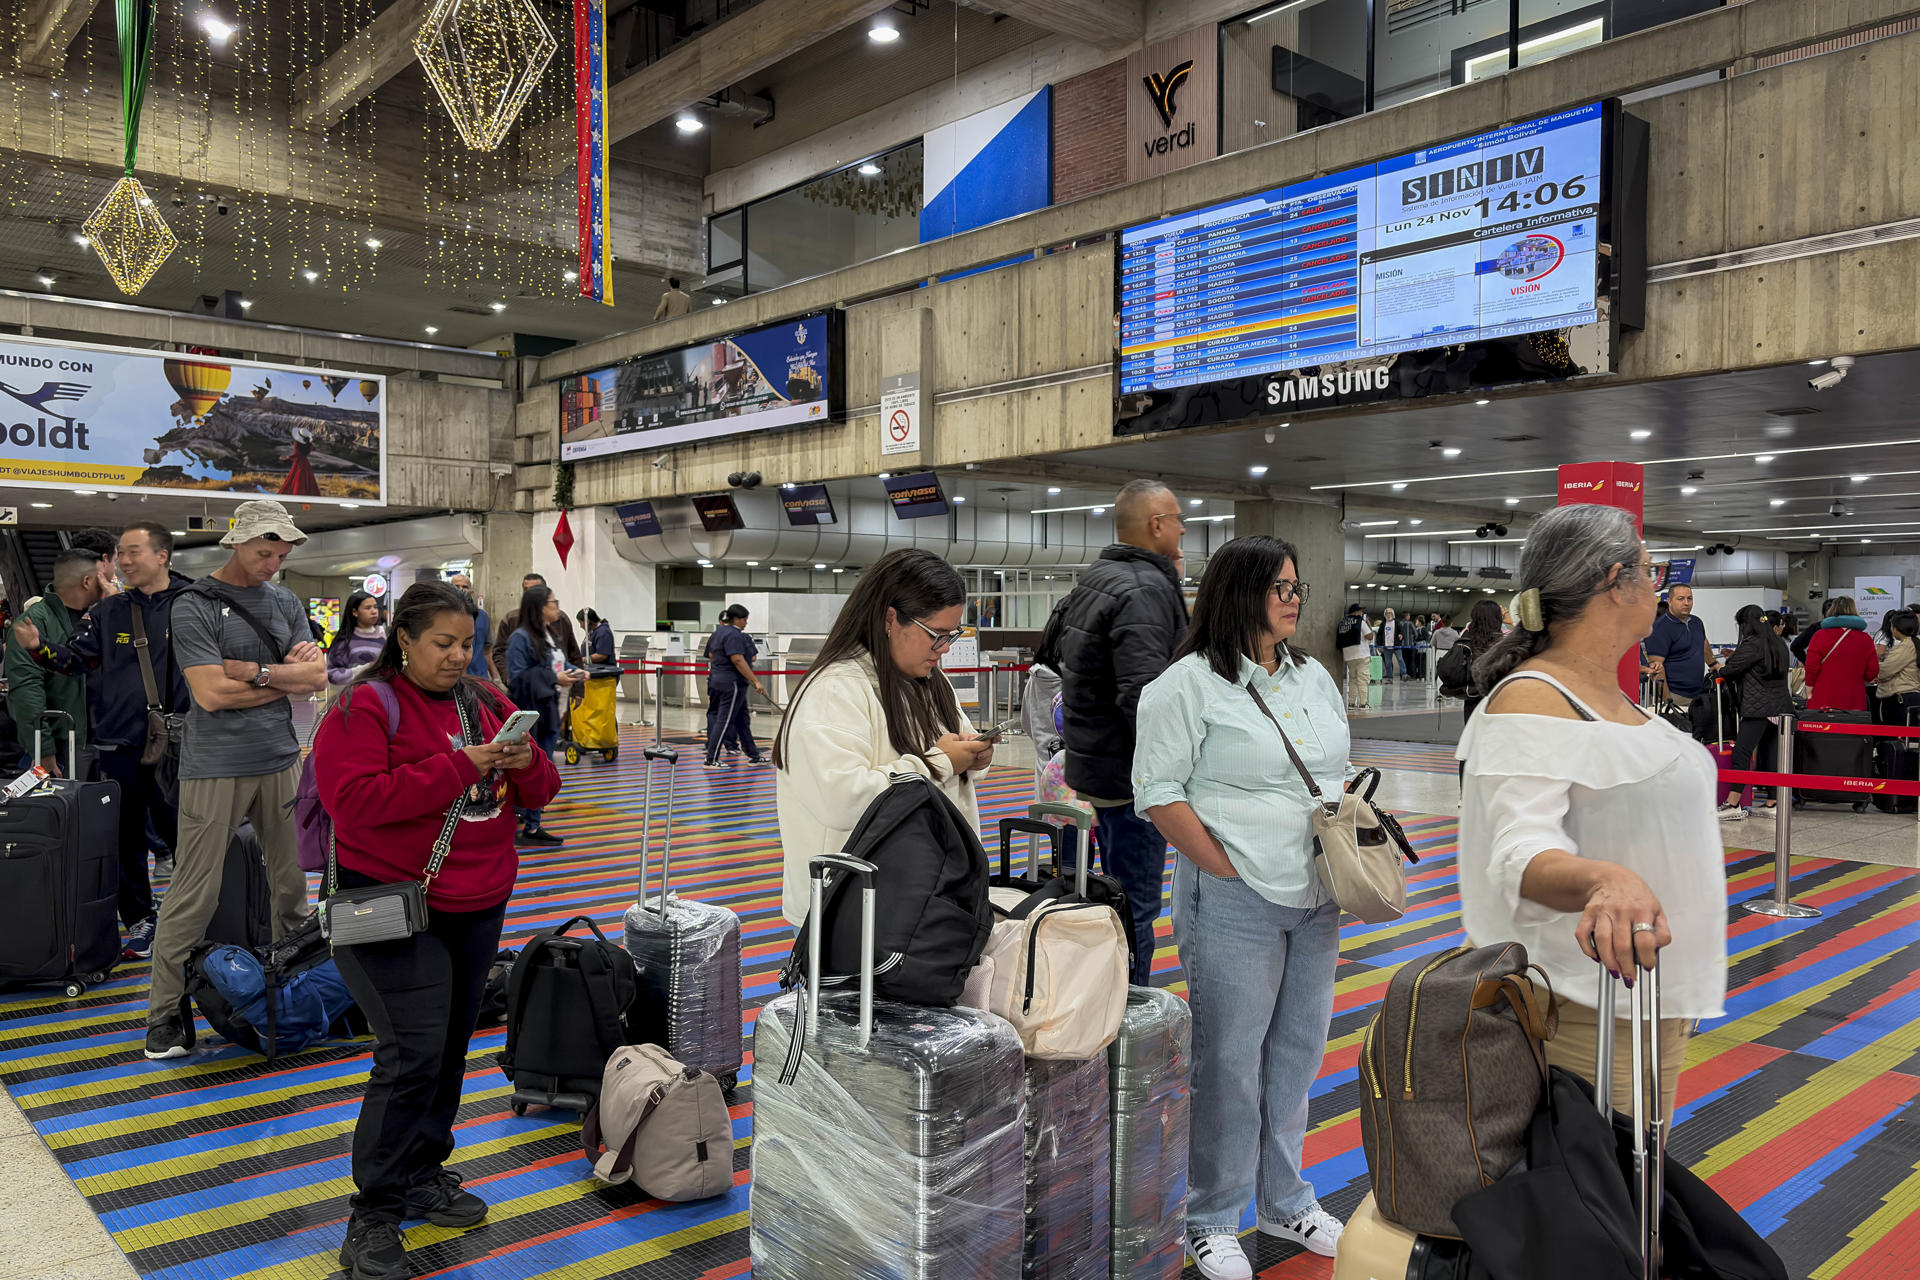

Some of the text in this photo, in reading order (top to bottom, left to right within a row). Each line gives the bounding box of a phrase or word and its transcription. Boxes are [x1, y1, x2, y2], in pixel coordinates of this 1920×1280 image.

[1144, 123, 1195, 158] verdi
[1428, 137, 1475, 155] AEROPUERTO
[1477, 120, 1538, 142] INTERNACIONAL
[1404, 147, 1541, 204] SINIV
[1401, 201, 1428, 213] Sistema
[1441, 188, 1483, 204] Información
[1484, 186, 1495, 194] de
[1497, 179, 1521, 191] Vuelos
[1474, 173, 1586, 220] 14:06
[1208, 226, 1237, 238] PANAMA
[1302, 205, 1323, 215] SALIO
[1385, 206, 1470, 234] Lun 24 Nov
[1473, 204, 1592, 238] Cartelera Informativa
[1129, 239, 1146, 247] HORA
[1163, 229, 1184, 238] VUELO
[1208, 242, 1242, 254] ESTAMBUL
[1301, 217, 1347, 233] CANCELADO
[1208, 234, 1240, 246] CURAZAO
[1208, 260, 1235, 271] BOGOTA
[1301, 235, 1347, 251] CANCELADO
[1207, 278, 1234, 288] MADRID
[1301, 253, 1347, 268] CANCELADO
[1208, 269, 1236, 280] PANAMA
[1375, 267, 1403, 281] MISIÓN
[1207, 284, 1239, 296] CURAZAO
[1510, 282, 1541, 296] VISIÓN
[1207, 294, 1235, 304] BOGOTA
[1207, 311, 1234, 321] MADRID
[1300, 289, 1346, 303] CANCELADO
[1207, 302, 1234, 312] MADRID
[1207, 319, 1235, 329] CANCUN
[1200, 368, 1236, 380] usuarios
[1240, 366, 1257, 376] que
[1287, 356, 1308, 367] sitio
[1312, 352, 1339, 363] 100%
[1342, 347, 1366, 358] libre
[1386, 339, 1417, 352] humo
[1419, 336, 1432, 346] de
[1436, 330, 1476, 344] tabaco
[1491, 324, 1514, 336] The
[1517, 316, 1564, 333] airport
[1207, 336, 1239, 346] CURAZAO
[1207, 346, 1228, 354] SANTA
[1250, 337, 1278, 346] MEXICO
[1206, 361, 1235, 370] PANAMA
[1207, 352, 1239, 362] CURAZAO
[59, 361, 93, 373] CON
[1268, 366, 1389, 404] SAMSUNG
[13, 467, 126, 480] @VIAJESHUMBOLDTPLUS
[1616, 480, 1634, 488] IBERIA
